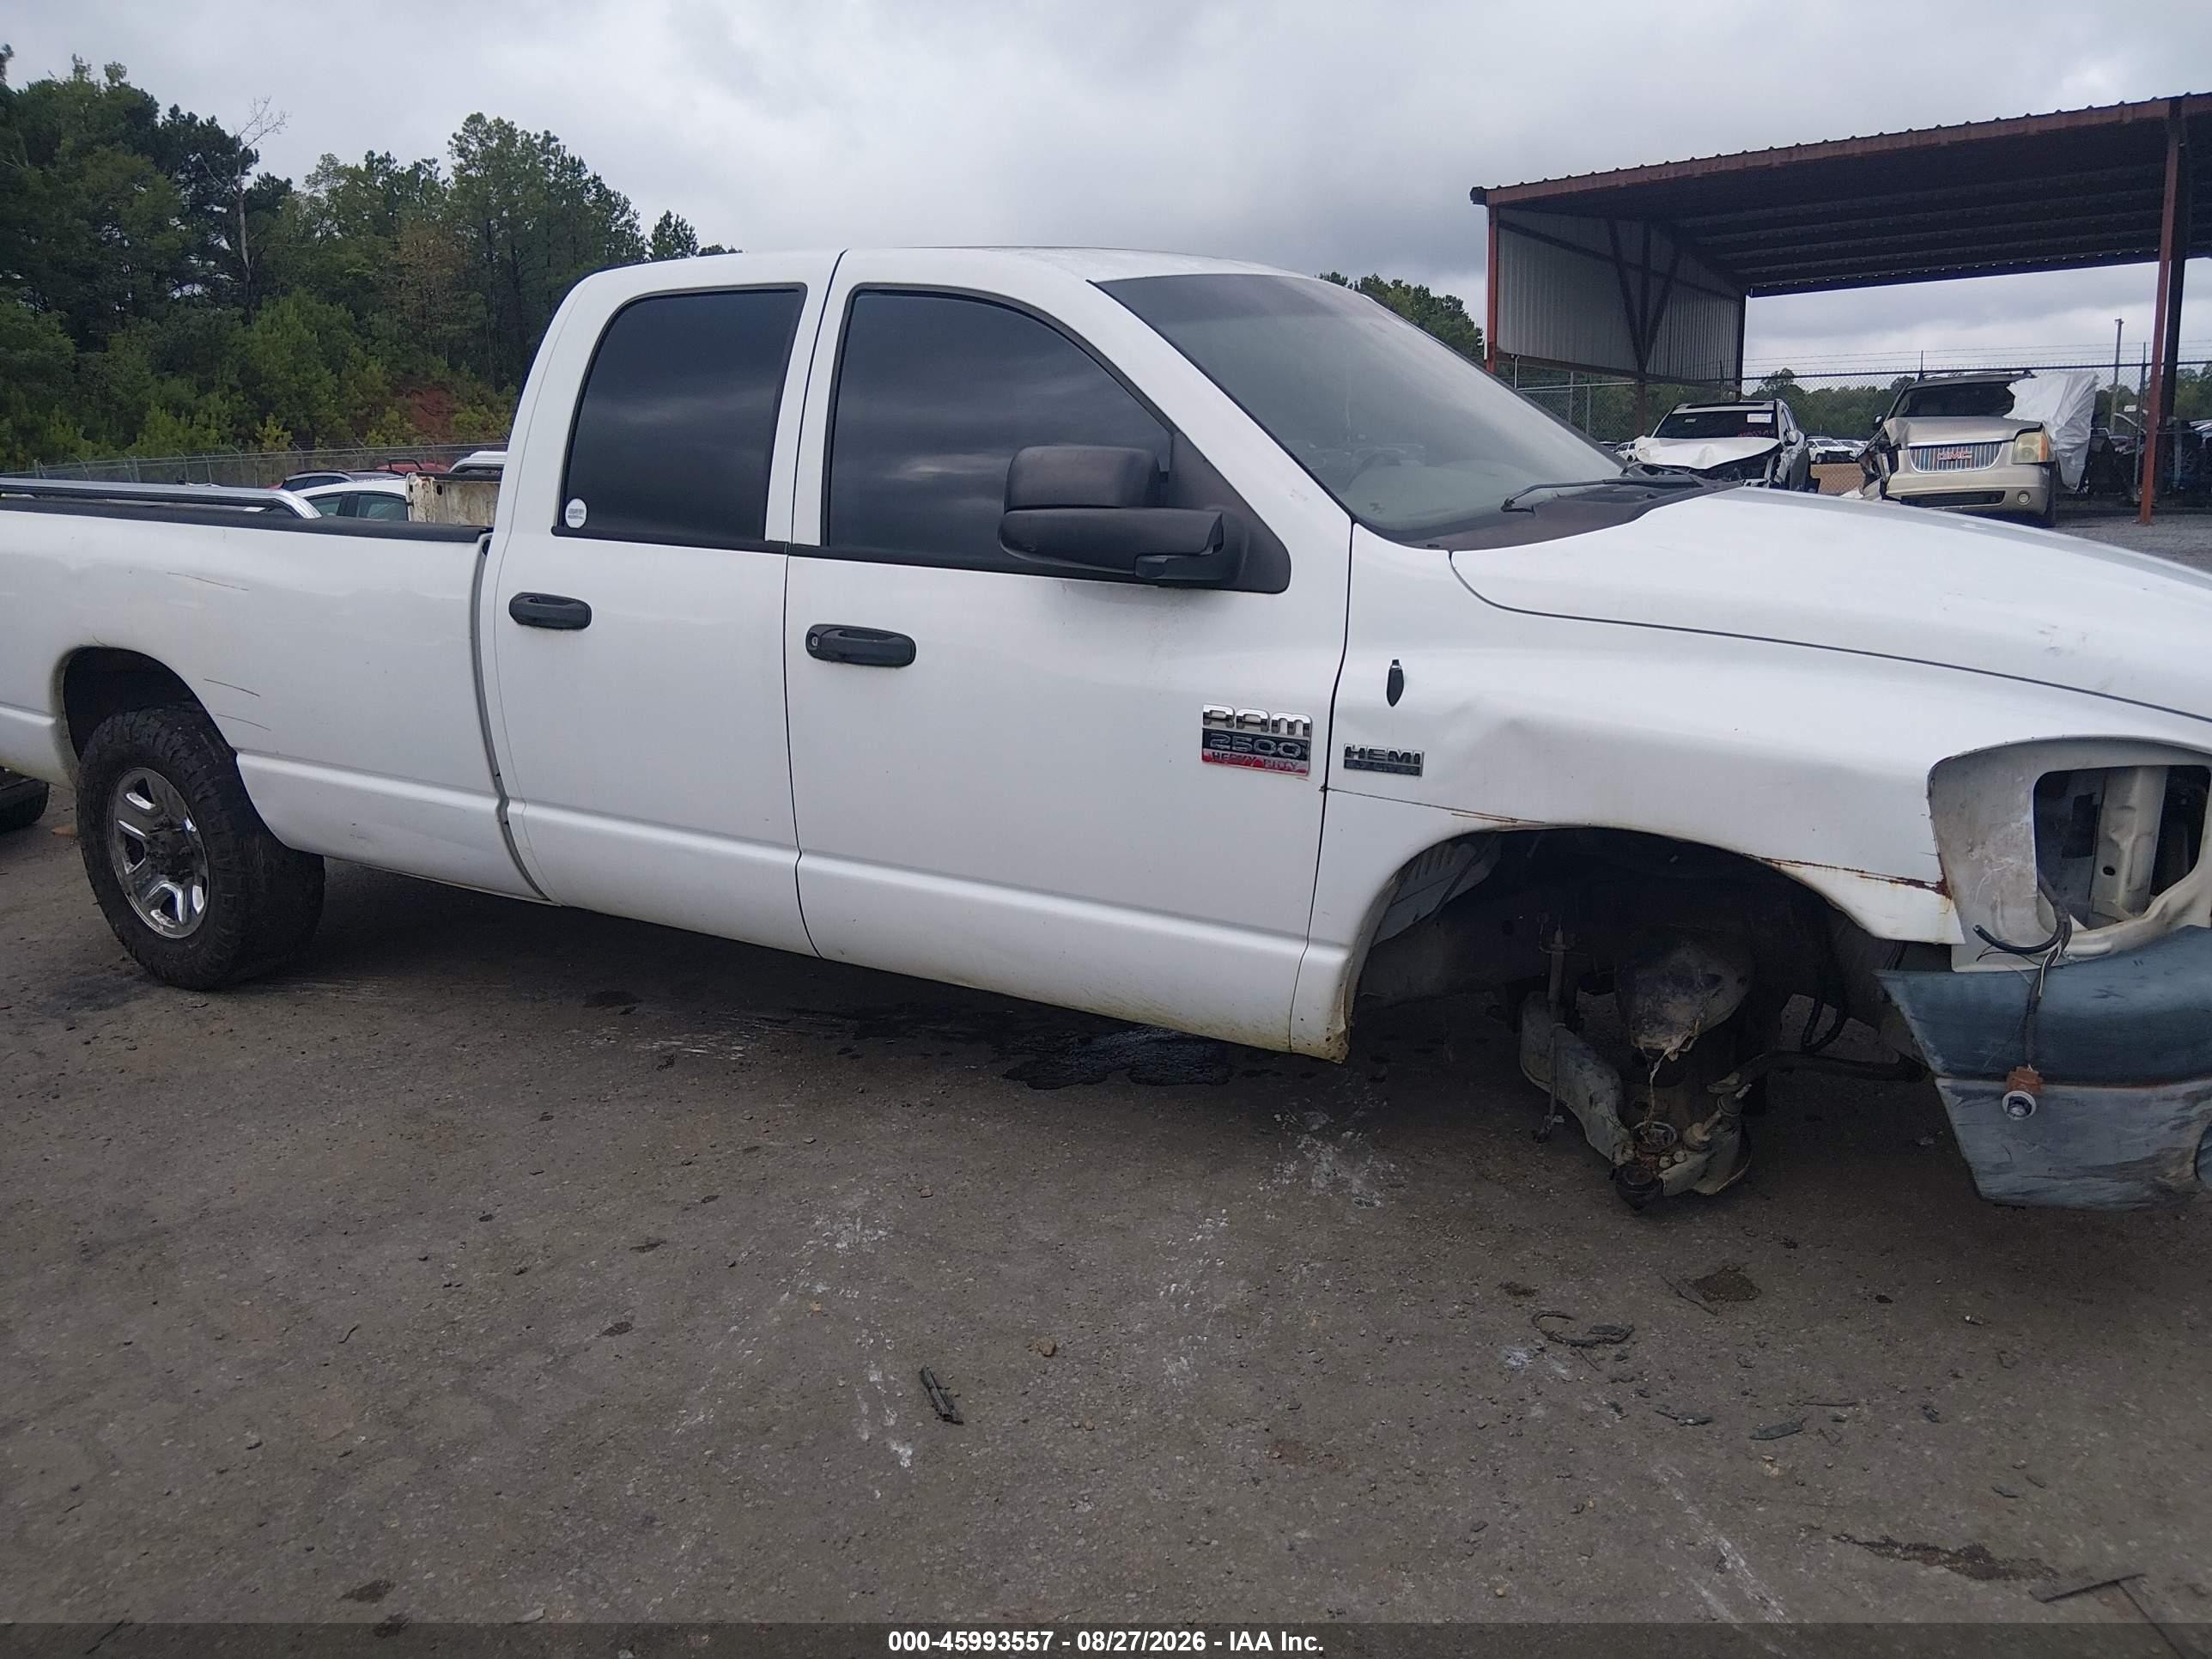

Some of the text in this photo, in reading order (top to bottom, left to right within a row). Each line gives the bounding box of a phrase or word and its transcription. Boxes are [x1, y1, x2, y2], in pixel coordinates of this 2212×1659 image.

[1937, 451, 1972, 460] GMC
[1202, 703, 1313, 737] RAM
[1209, 732, 1303, 758] 2500
[1344, 744, 1424, 766] HEMI
